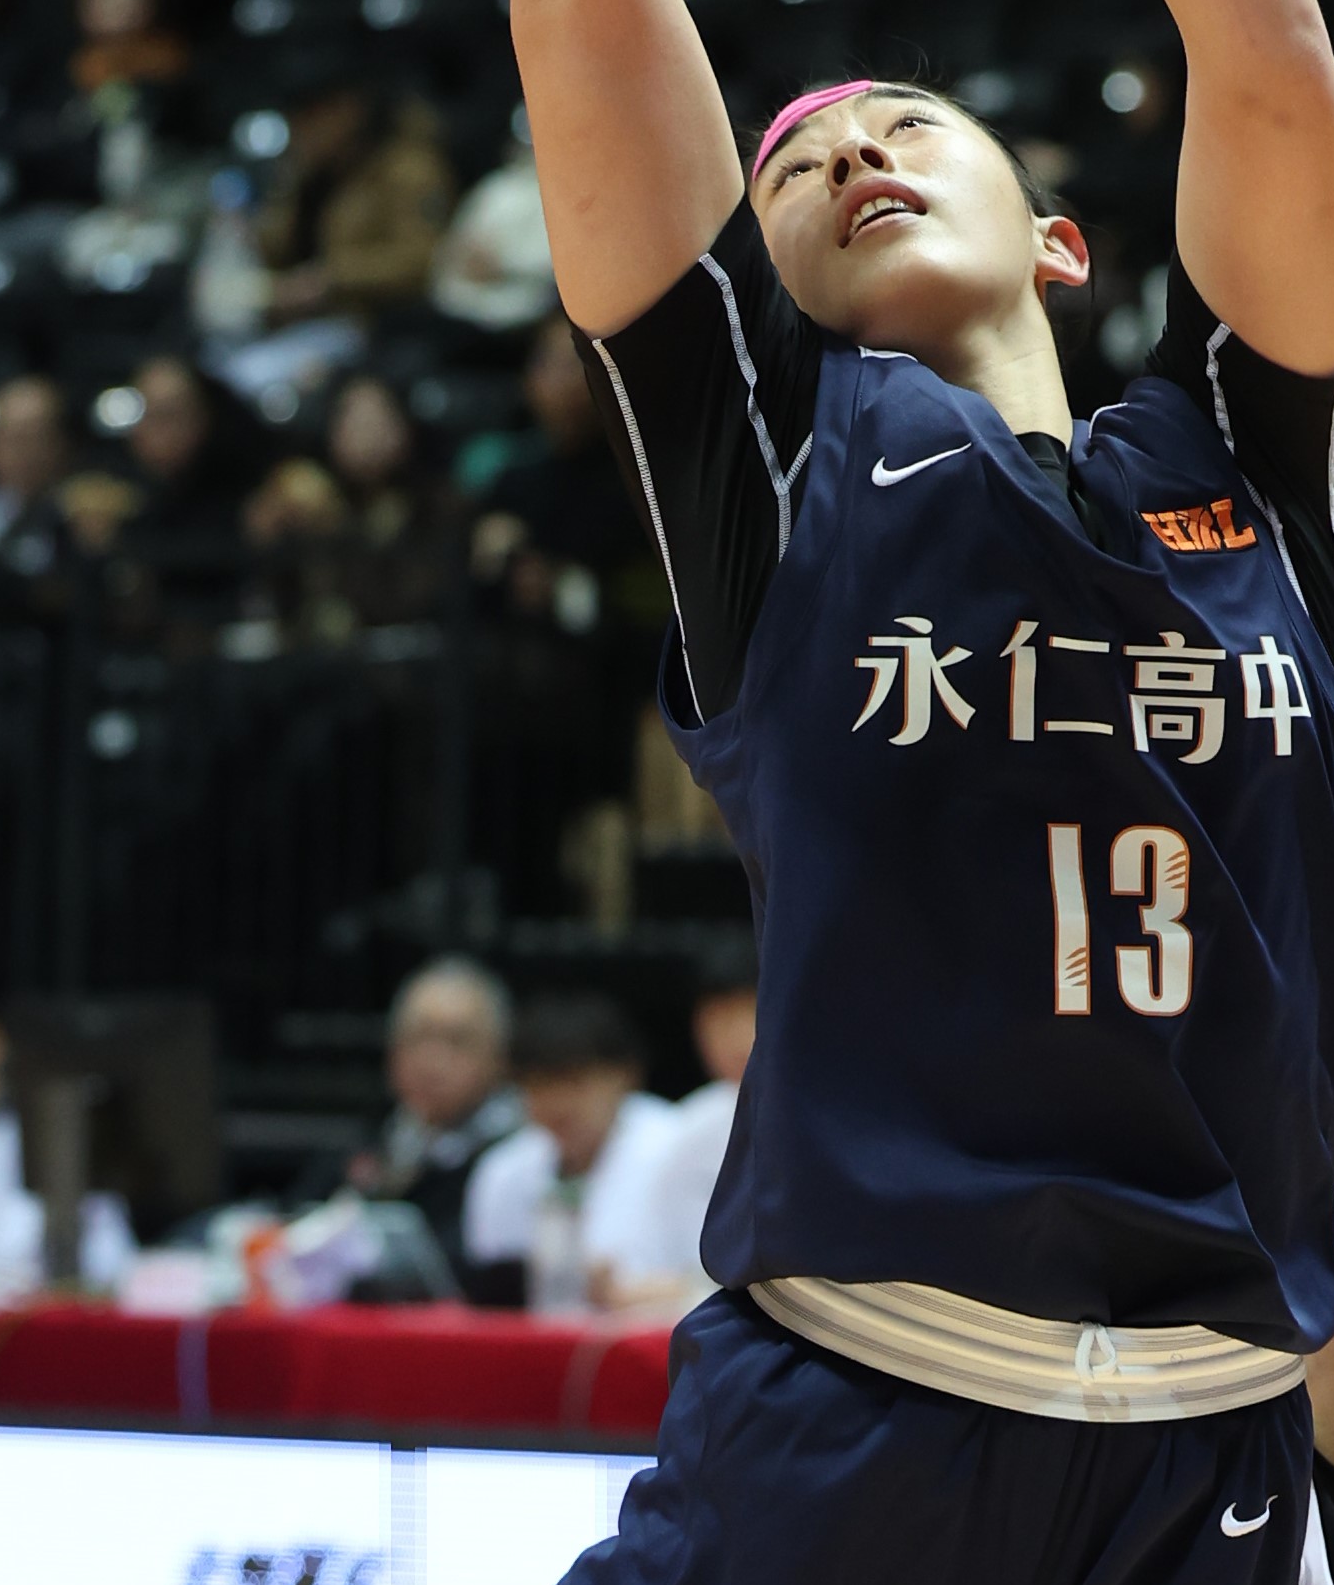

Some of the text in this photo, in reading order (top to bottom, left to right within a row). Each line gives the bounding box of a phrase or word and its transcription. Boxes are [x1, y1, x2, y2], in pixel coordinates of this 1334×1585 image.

[851, 616, 1312, 765] 永仁高中
[1046, 823, 1194, 1017] 13
